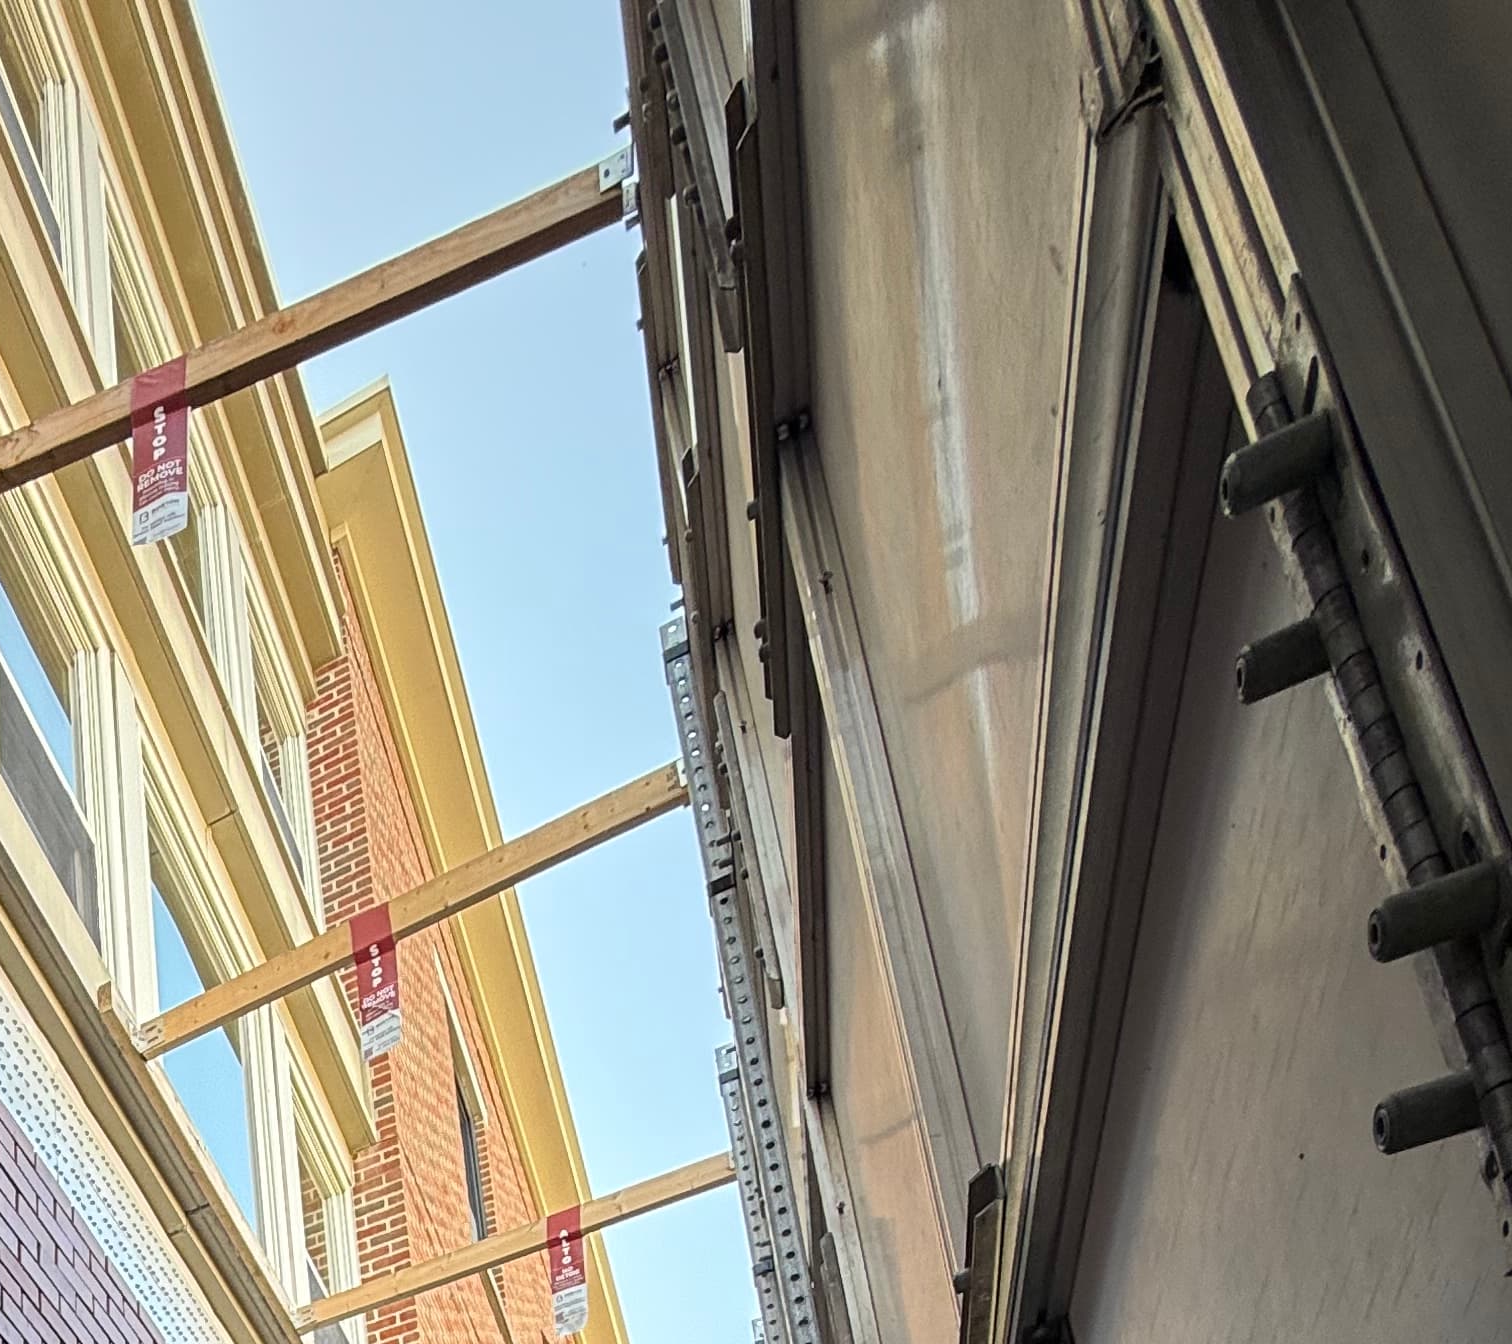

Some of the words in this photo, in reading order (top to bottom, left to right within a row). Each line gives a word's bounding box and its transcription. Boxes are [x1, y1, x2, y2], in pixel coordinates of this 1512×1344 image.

[152, 405, 168, 462] STOP
[137, 467, 184, 492] REMOVE
[157, 459, 183, 473] NOT
[368, 943, 383, 989] STOP
